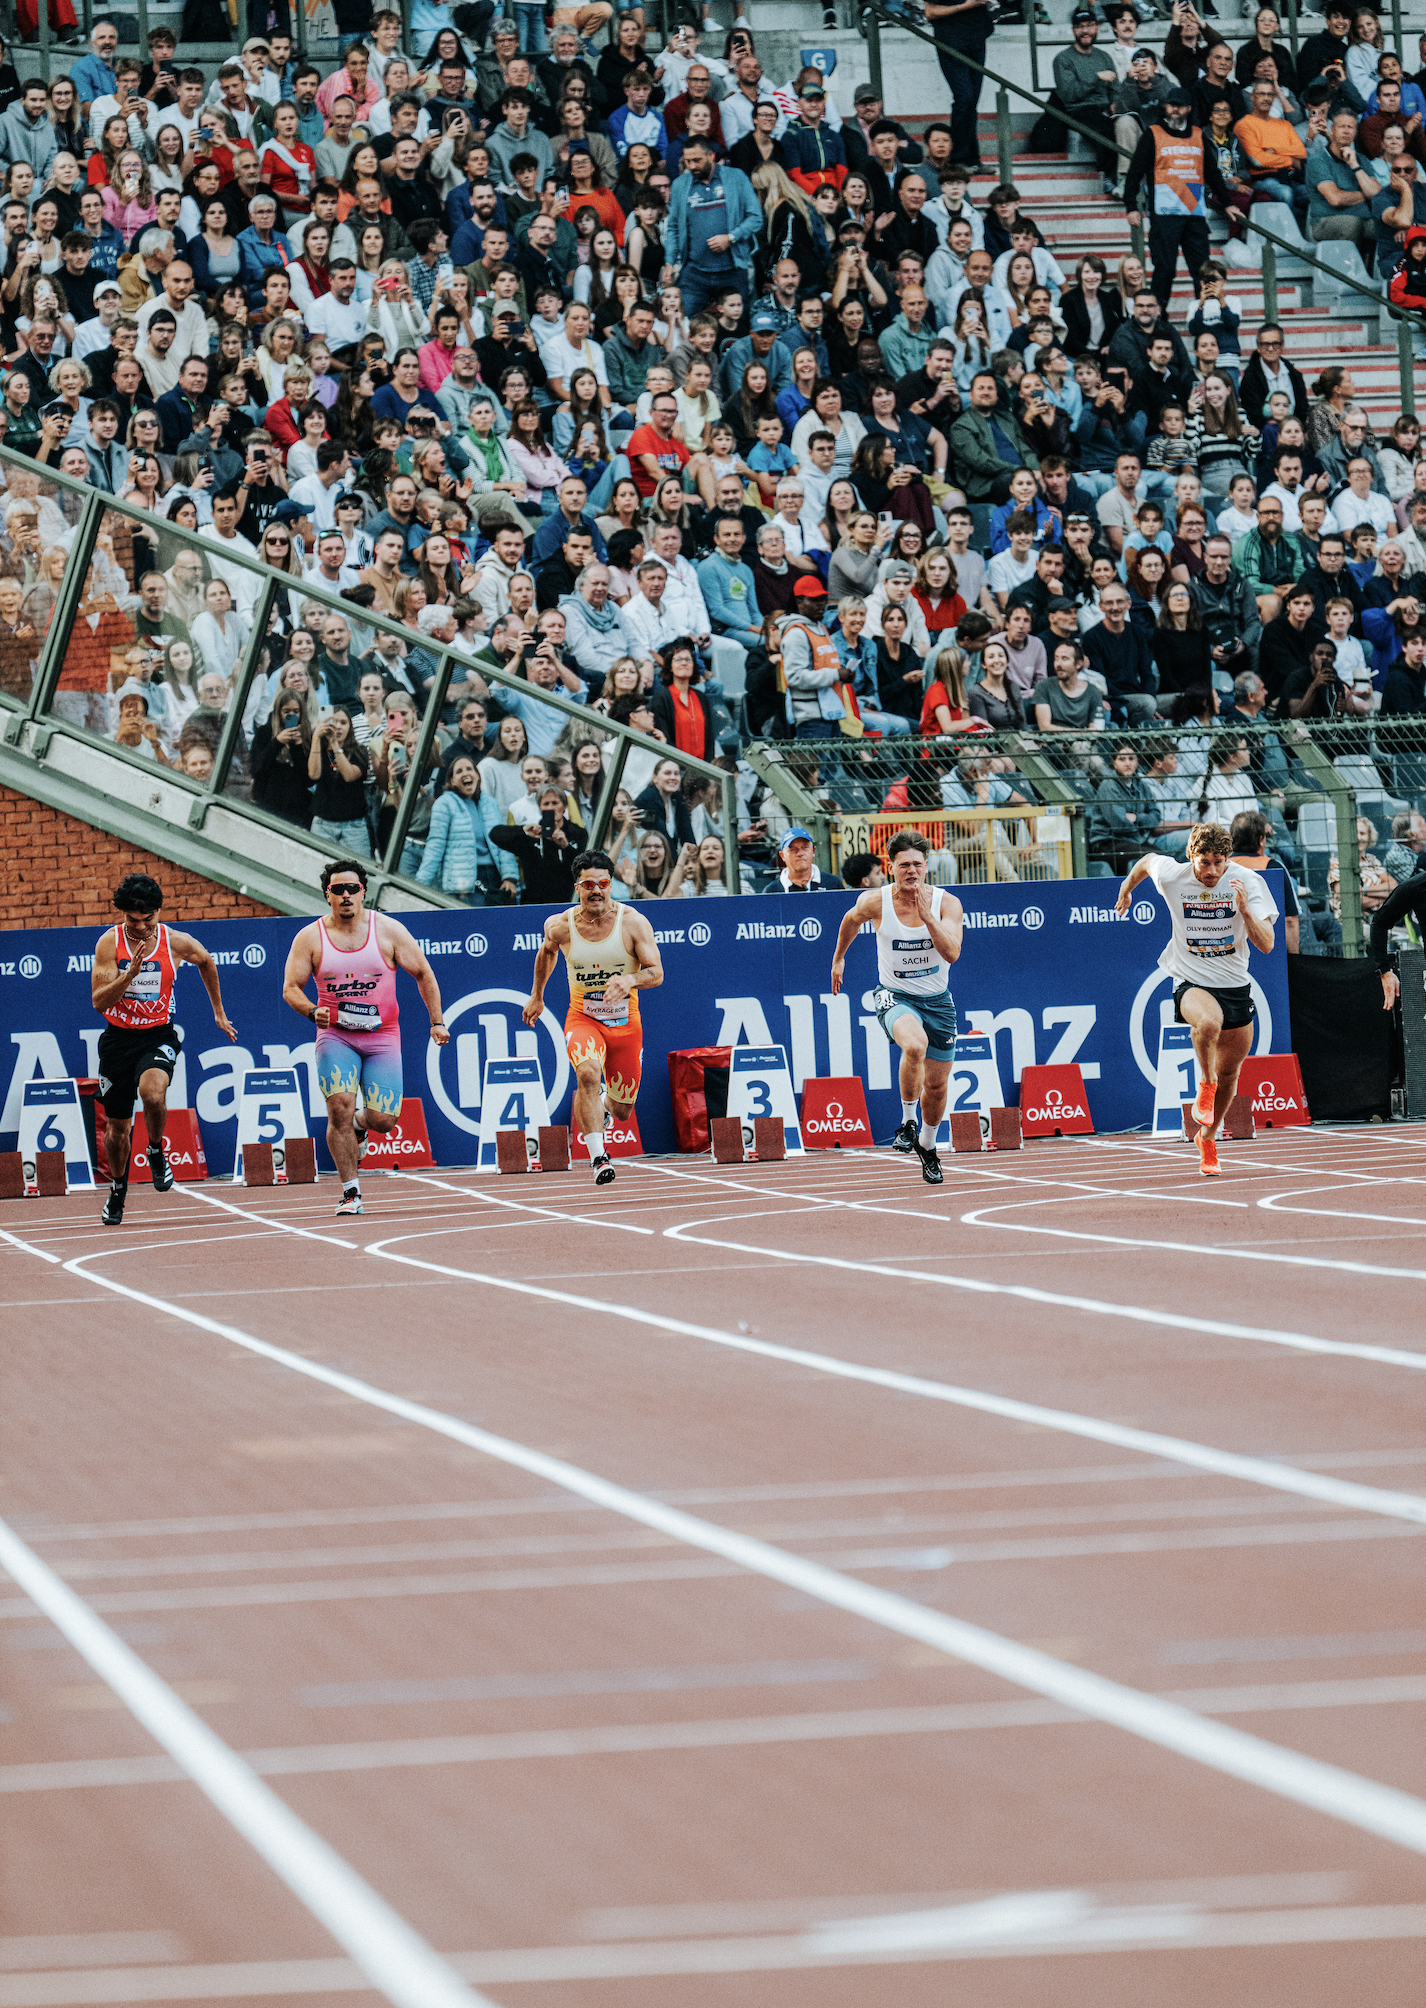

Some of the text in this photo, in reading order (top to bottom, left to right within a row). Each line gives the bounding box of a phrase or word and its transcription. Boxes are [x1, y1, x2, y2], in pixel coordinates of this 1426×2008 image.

[844, 825, 868, 858] 36
[961, 911, 1018, 929] Allianz
[1069, 906, 1130, 924] Allianz
[735, 922, 796, 940] Allianz
[415, 938, 463, 955] lianz
[902, 956, 929, 965] SACHI
[905, 969, 931, 978] BRUSSELS
[326, 980, 377, 992] turbo
[335, 990, 368, 998] SPRINT
[344, 1003, 368, 1014] Allianz
[586, 1006, 613, 1014] AVERAGE
[715, 992, 1102, 1095] Allinz
[1178, 1059, 1199, 1100] 1
[953, 1069, 979, 1110] 2
[747, 1080, 773, 1121] 3
[1251, 1097, 1298, 1112] MEGA
[499, 1093, 530, 1131] 4
[1026, 1105, 1086, 1122] OMEGA
[258, 1103, 285, 1144] 5
[806, 1118, 866, 1134] OMEGA
[37, 1114, 66, 1152] 6
[577, 1130, 637, 1145] OEGA
[367, 1140, 426, 1156] OMEGA
[134, 1151, 193, 1167] OGA
